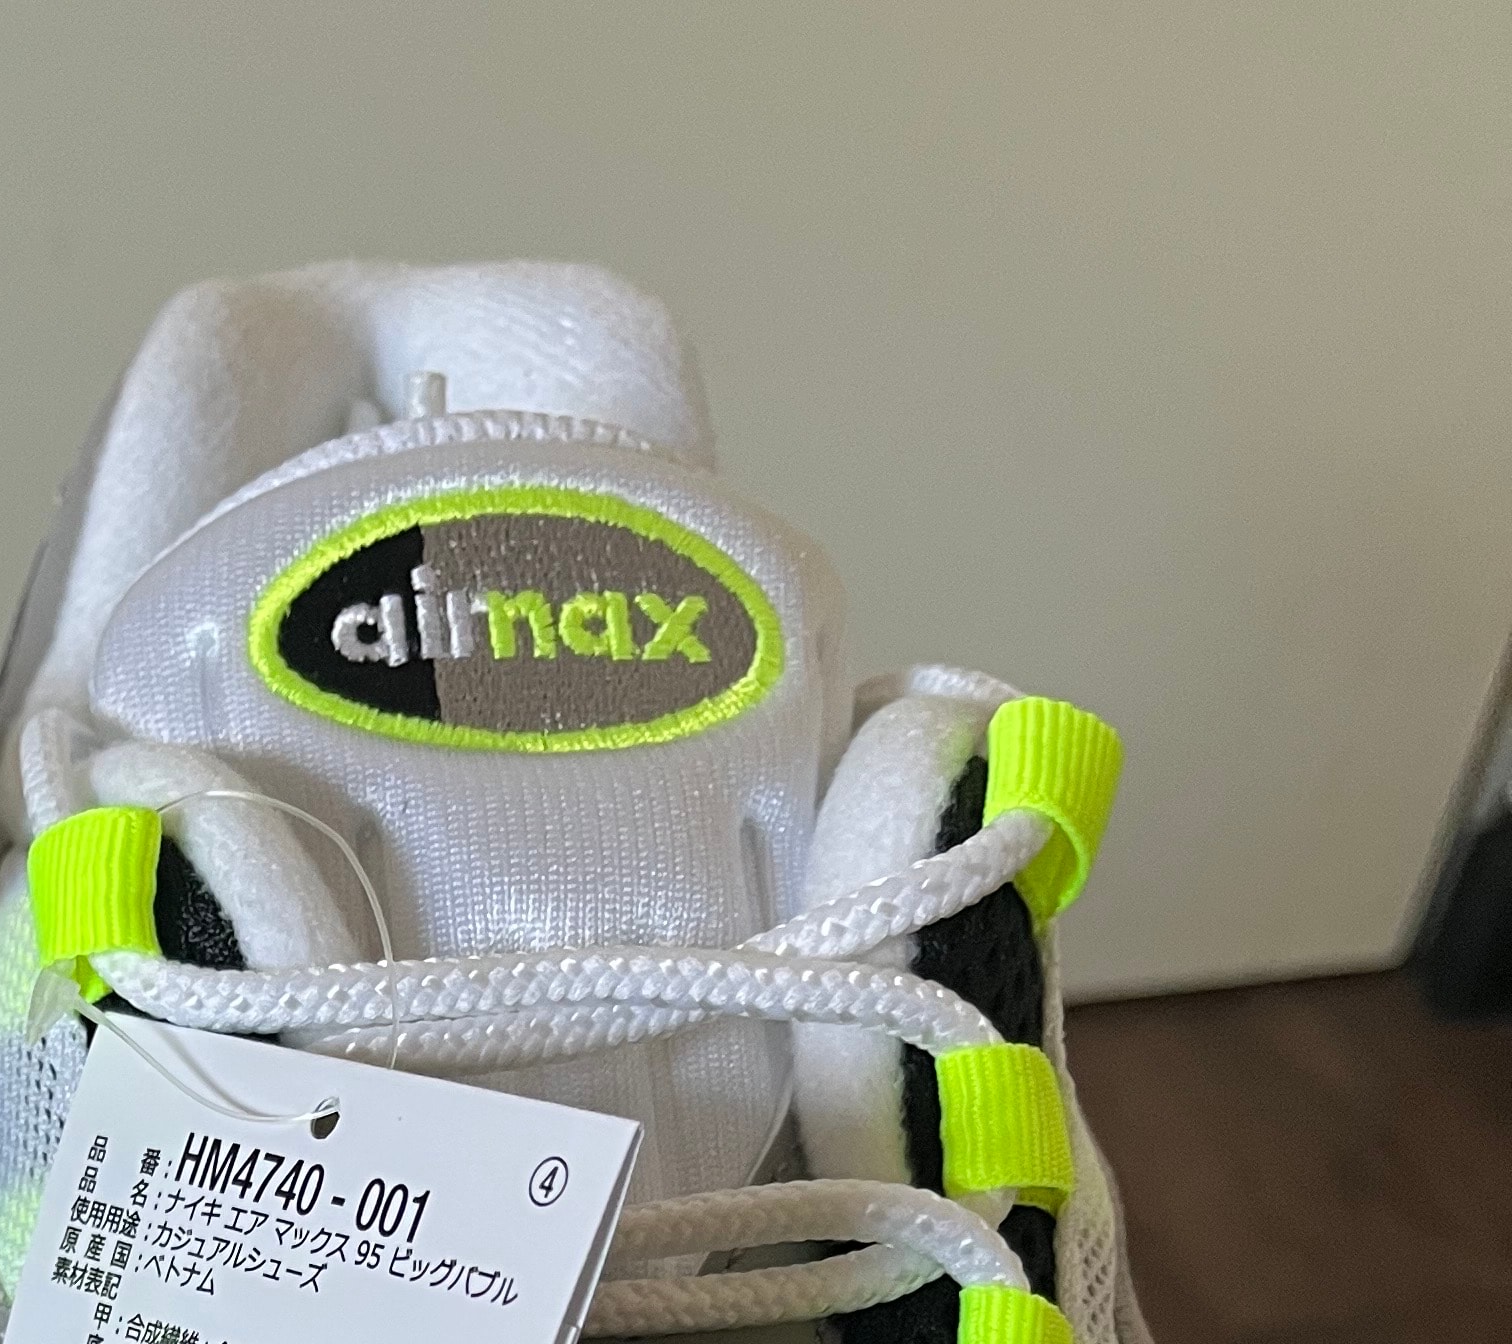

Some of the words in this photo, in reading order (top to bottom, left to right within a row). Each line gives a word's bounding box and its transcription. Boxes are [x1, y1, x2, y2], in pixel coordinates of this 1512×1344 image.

[275, 1217, 350, 1262] マックス
[355, 1240, 385, 1269] 95
[50, 1257, 122, 1300] 素材表記
